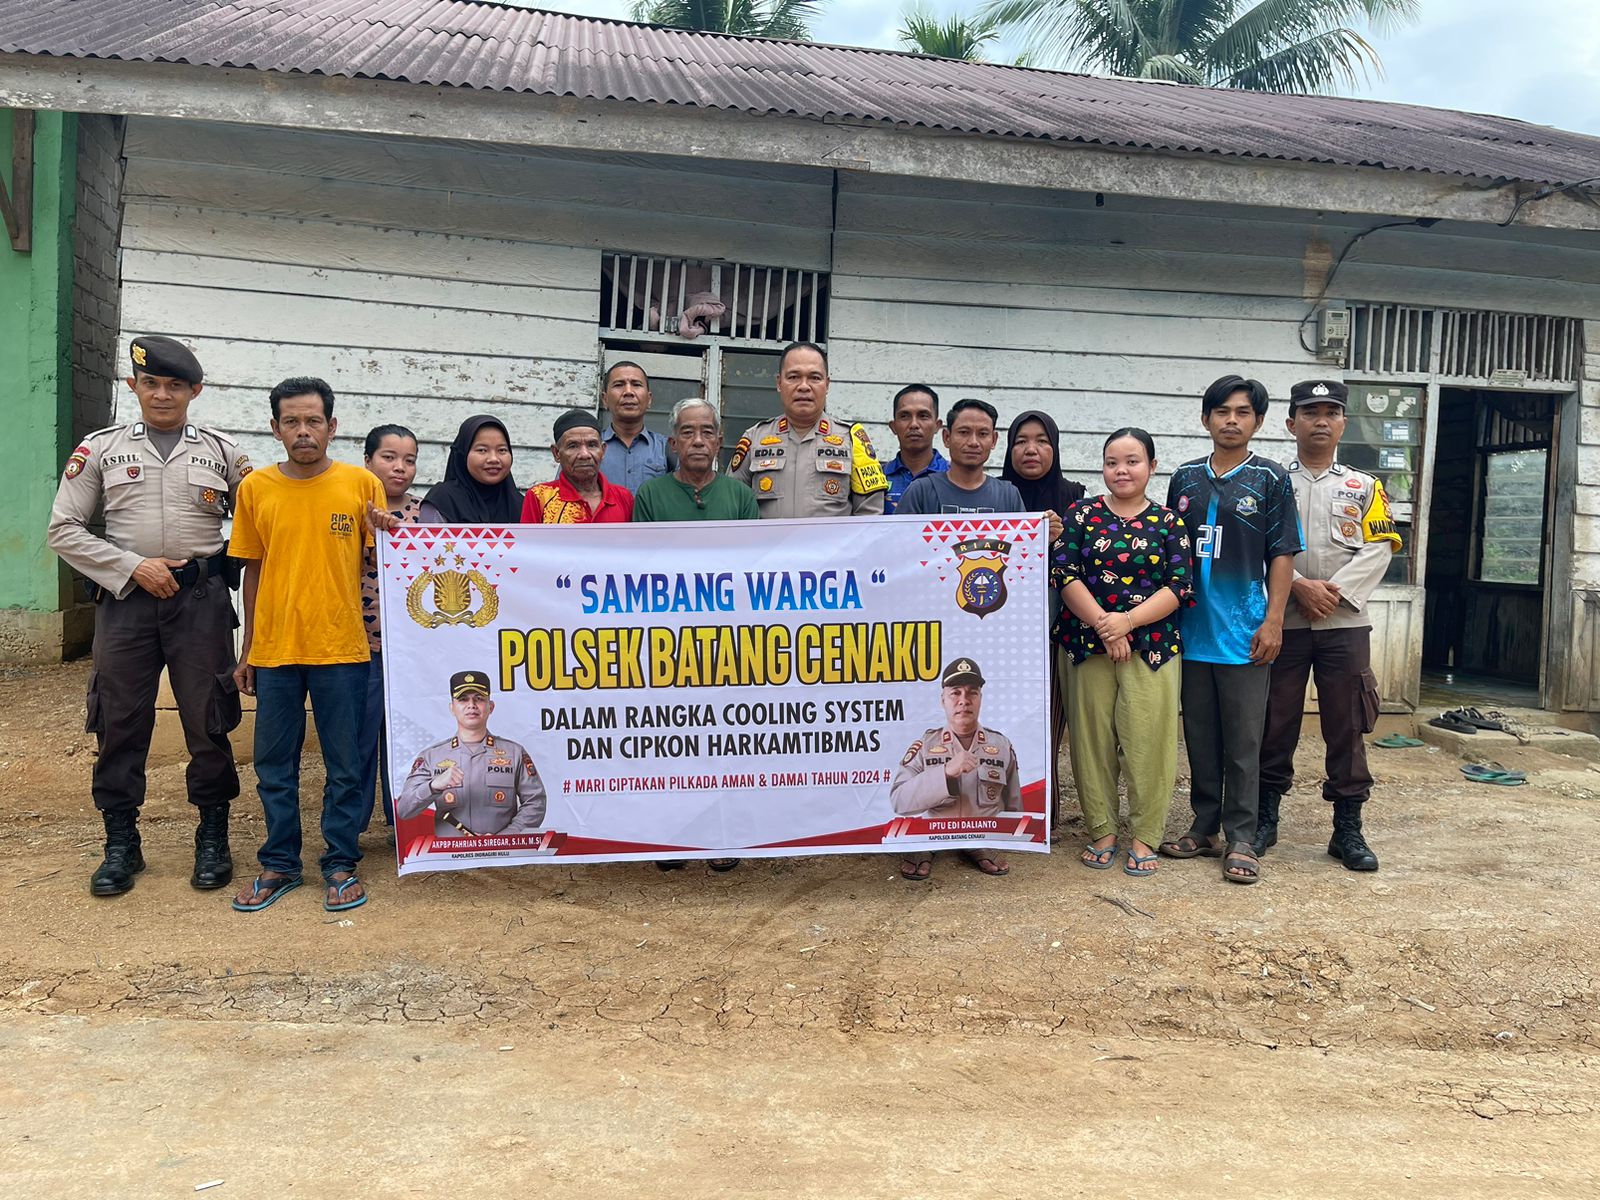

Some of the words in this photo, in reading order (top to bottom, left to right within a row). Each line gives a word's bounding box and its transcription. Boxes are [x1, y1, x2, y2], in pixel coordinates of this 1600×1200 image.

[817, 449, 848, 457] POLRI
[102, 454, 140, 467] ASRIL
[191, 456, 226, 474] POLRI
[1338, 490, 1366, 502] POLR
[331, 513, 348, 522] RIP
[331, 522, 352, 532] CURL
[960, 541, 1005, 552] RIAU
[1196, 524, 1223, 559] 21
[580, 572, 735, 614] SAMBANG
[744, 570, 863, 611] WARGA
[498, 627, 646, 691] POLSEK
[648, 623, 792, 688] BATANG
[795, 620, 942, 686] CENAKU
[541, 706, 617, 731] DALAM
[625, 704, 717, 728] RANGKA
[722, 701, 817, 726] COOLING
[825, 699, 905, 724] SYSTEM
[567, 737, 612, 760] DAN
[619, 734, 699, 759] CIPKON
[708, 729, 881, 757] HARKAMTIBMAS
[575, 779, 605, 793] MARI
[609, 777, 665, 792] CIPTAKAN
[669, 775, 718, 790] PILKADA
[722, 774, 754, 788] AMAN
[759, 774, 767, 787] &
[771, 773, 807, 787] DAMAI
[811, 771, 848, 785] TAHUN
[851, 770, 880, 784] 2024
[929, 822, 946, 830] IPTU
[961, 821, 997, 829] DALIANTO
[452, 839, 477, 848] FAHRIAN
